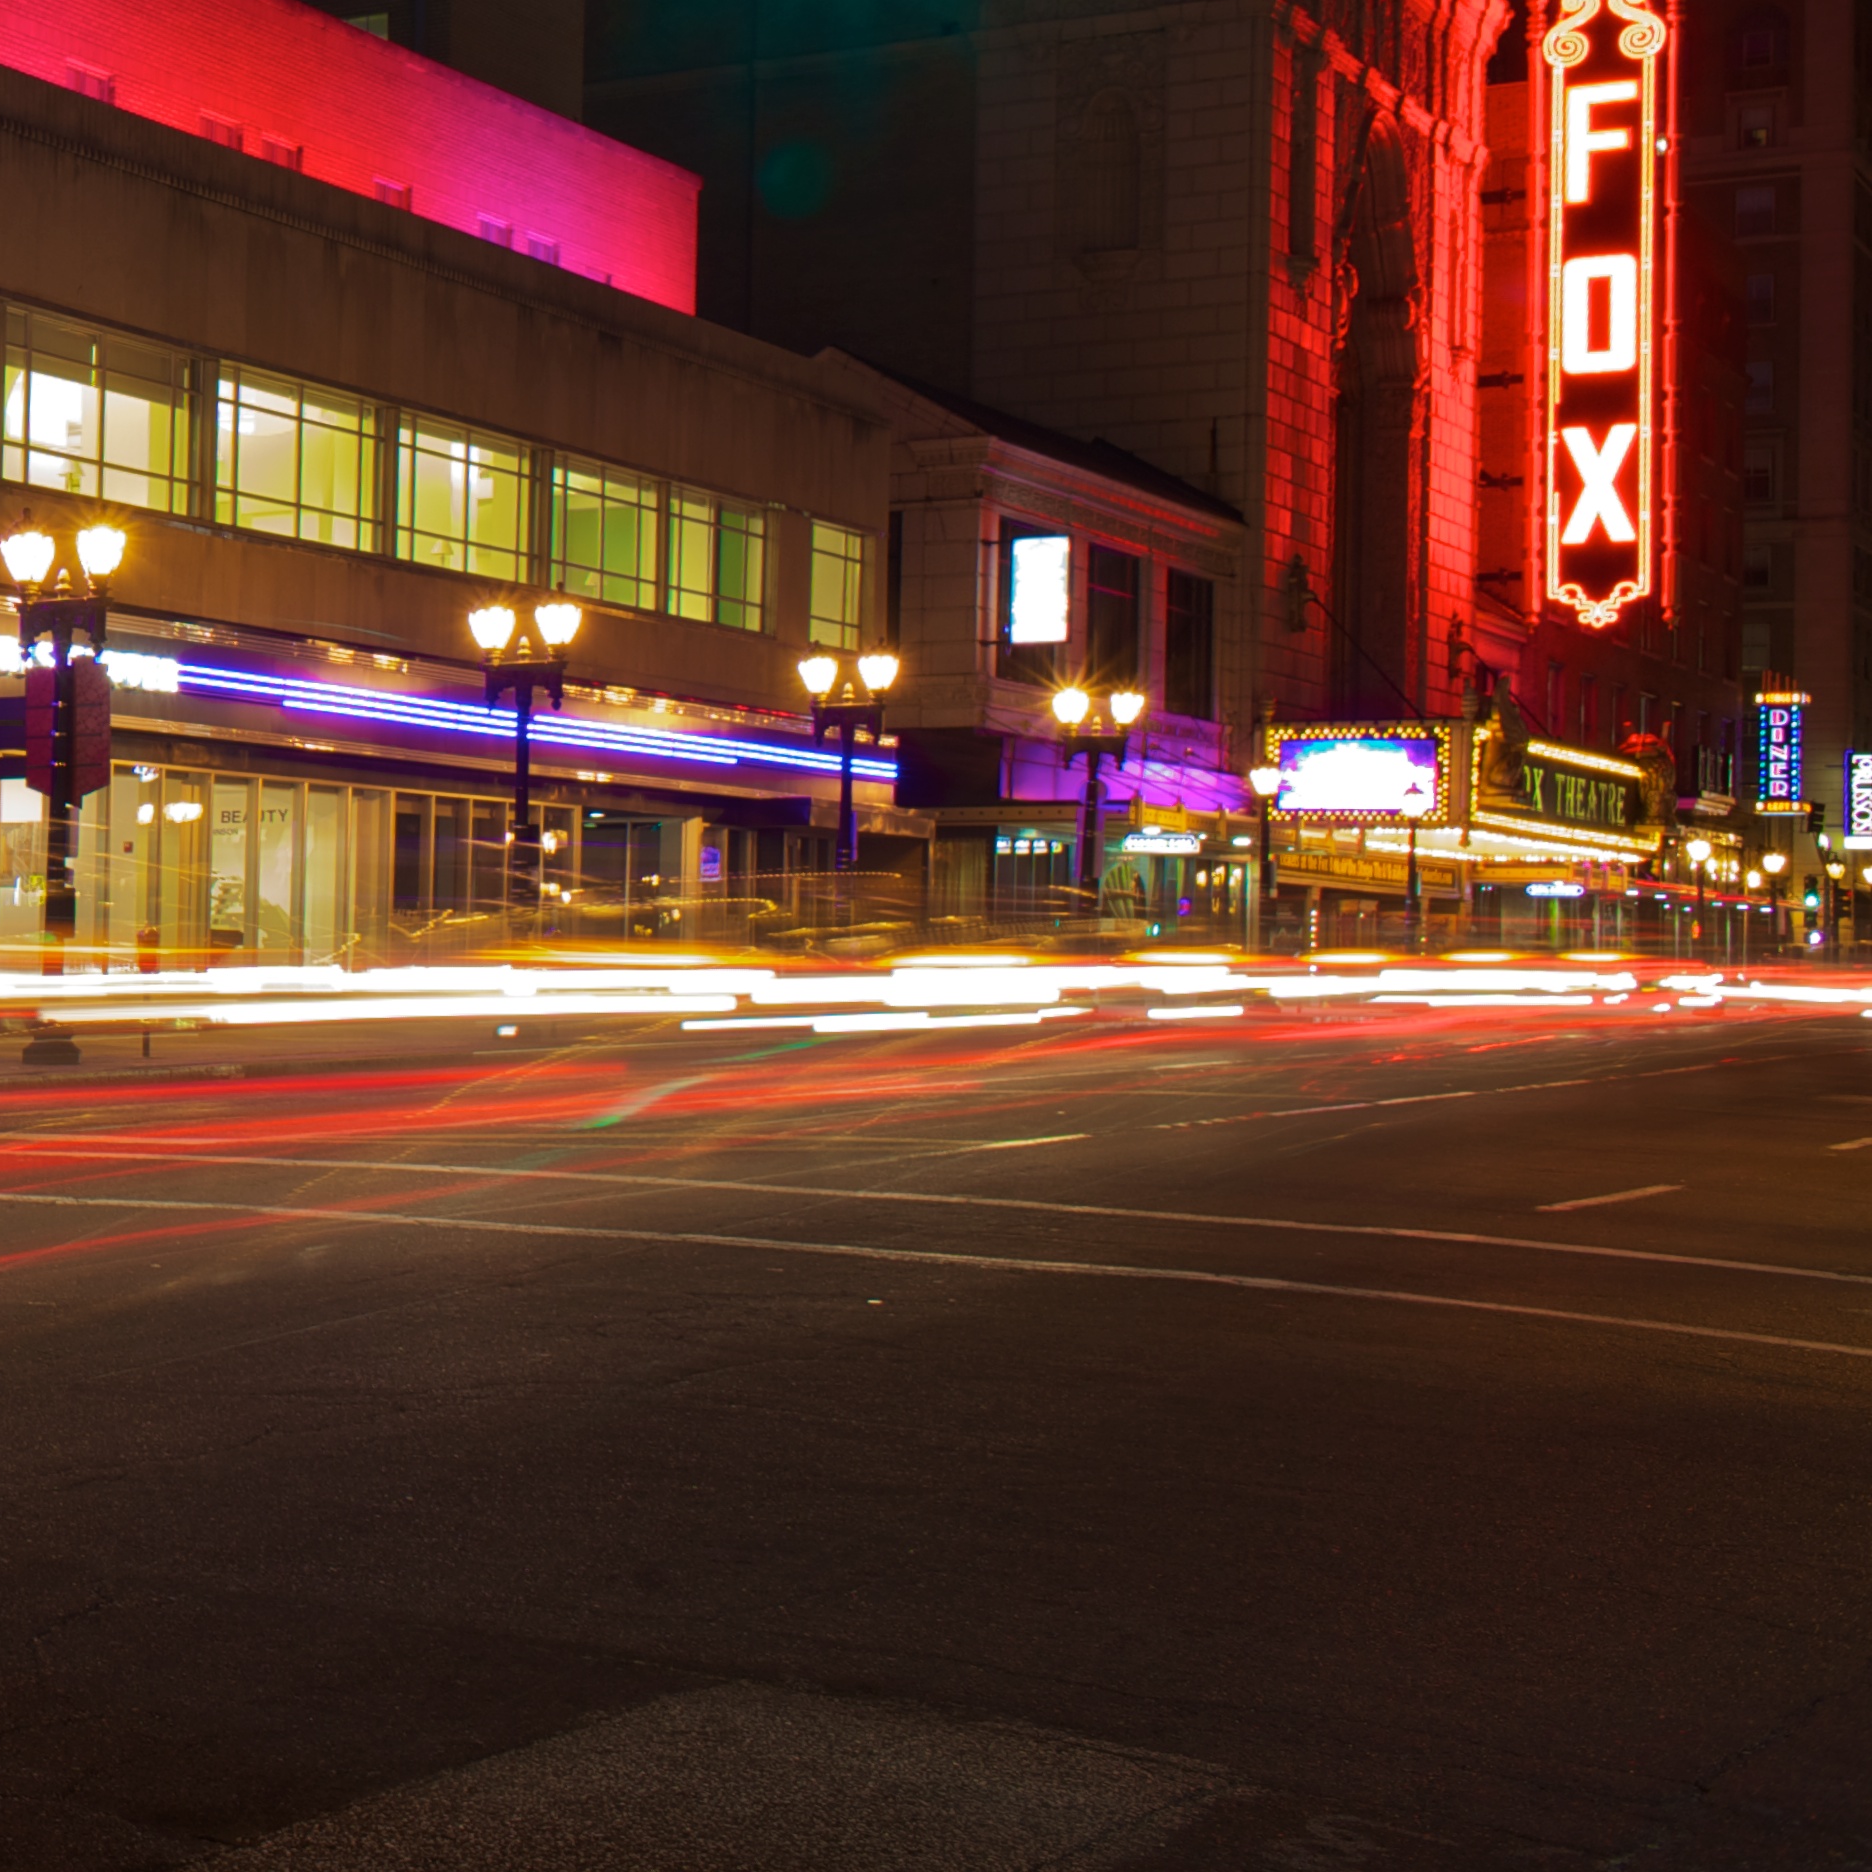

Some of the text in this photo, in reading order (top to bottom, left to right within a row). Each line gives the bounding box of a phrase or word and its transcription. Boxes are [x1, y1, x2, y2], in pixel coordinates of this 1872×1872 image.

[1562, 81, 1638, 544] FOX
[1768, 708, 1791, 797] DINER
[1554, 771, 1627, 827] THEATRE
